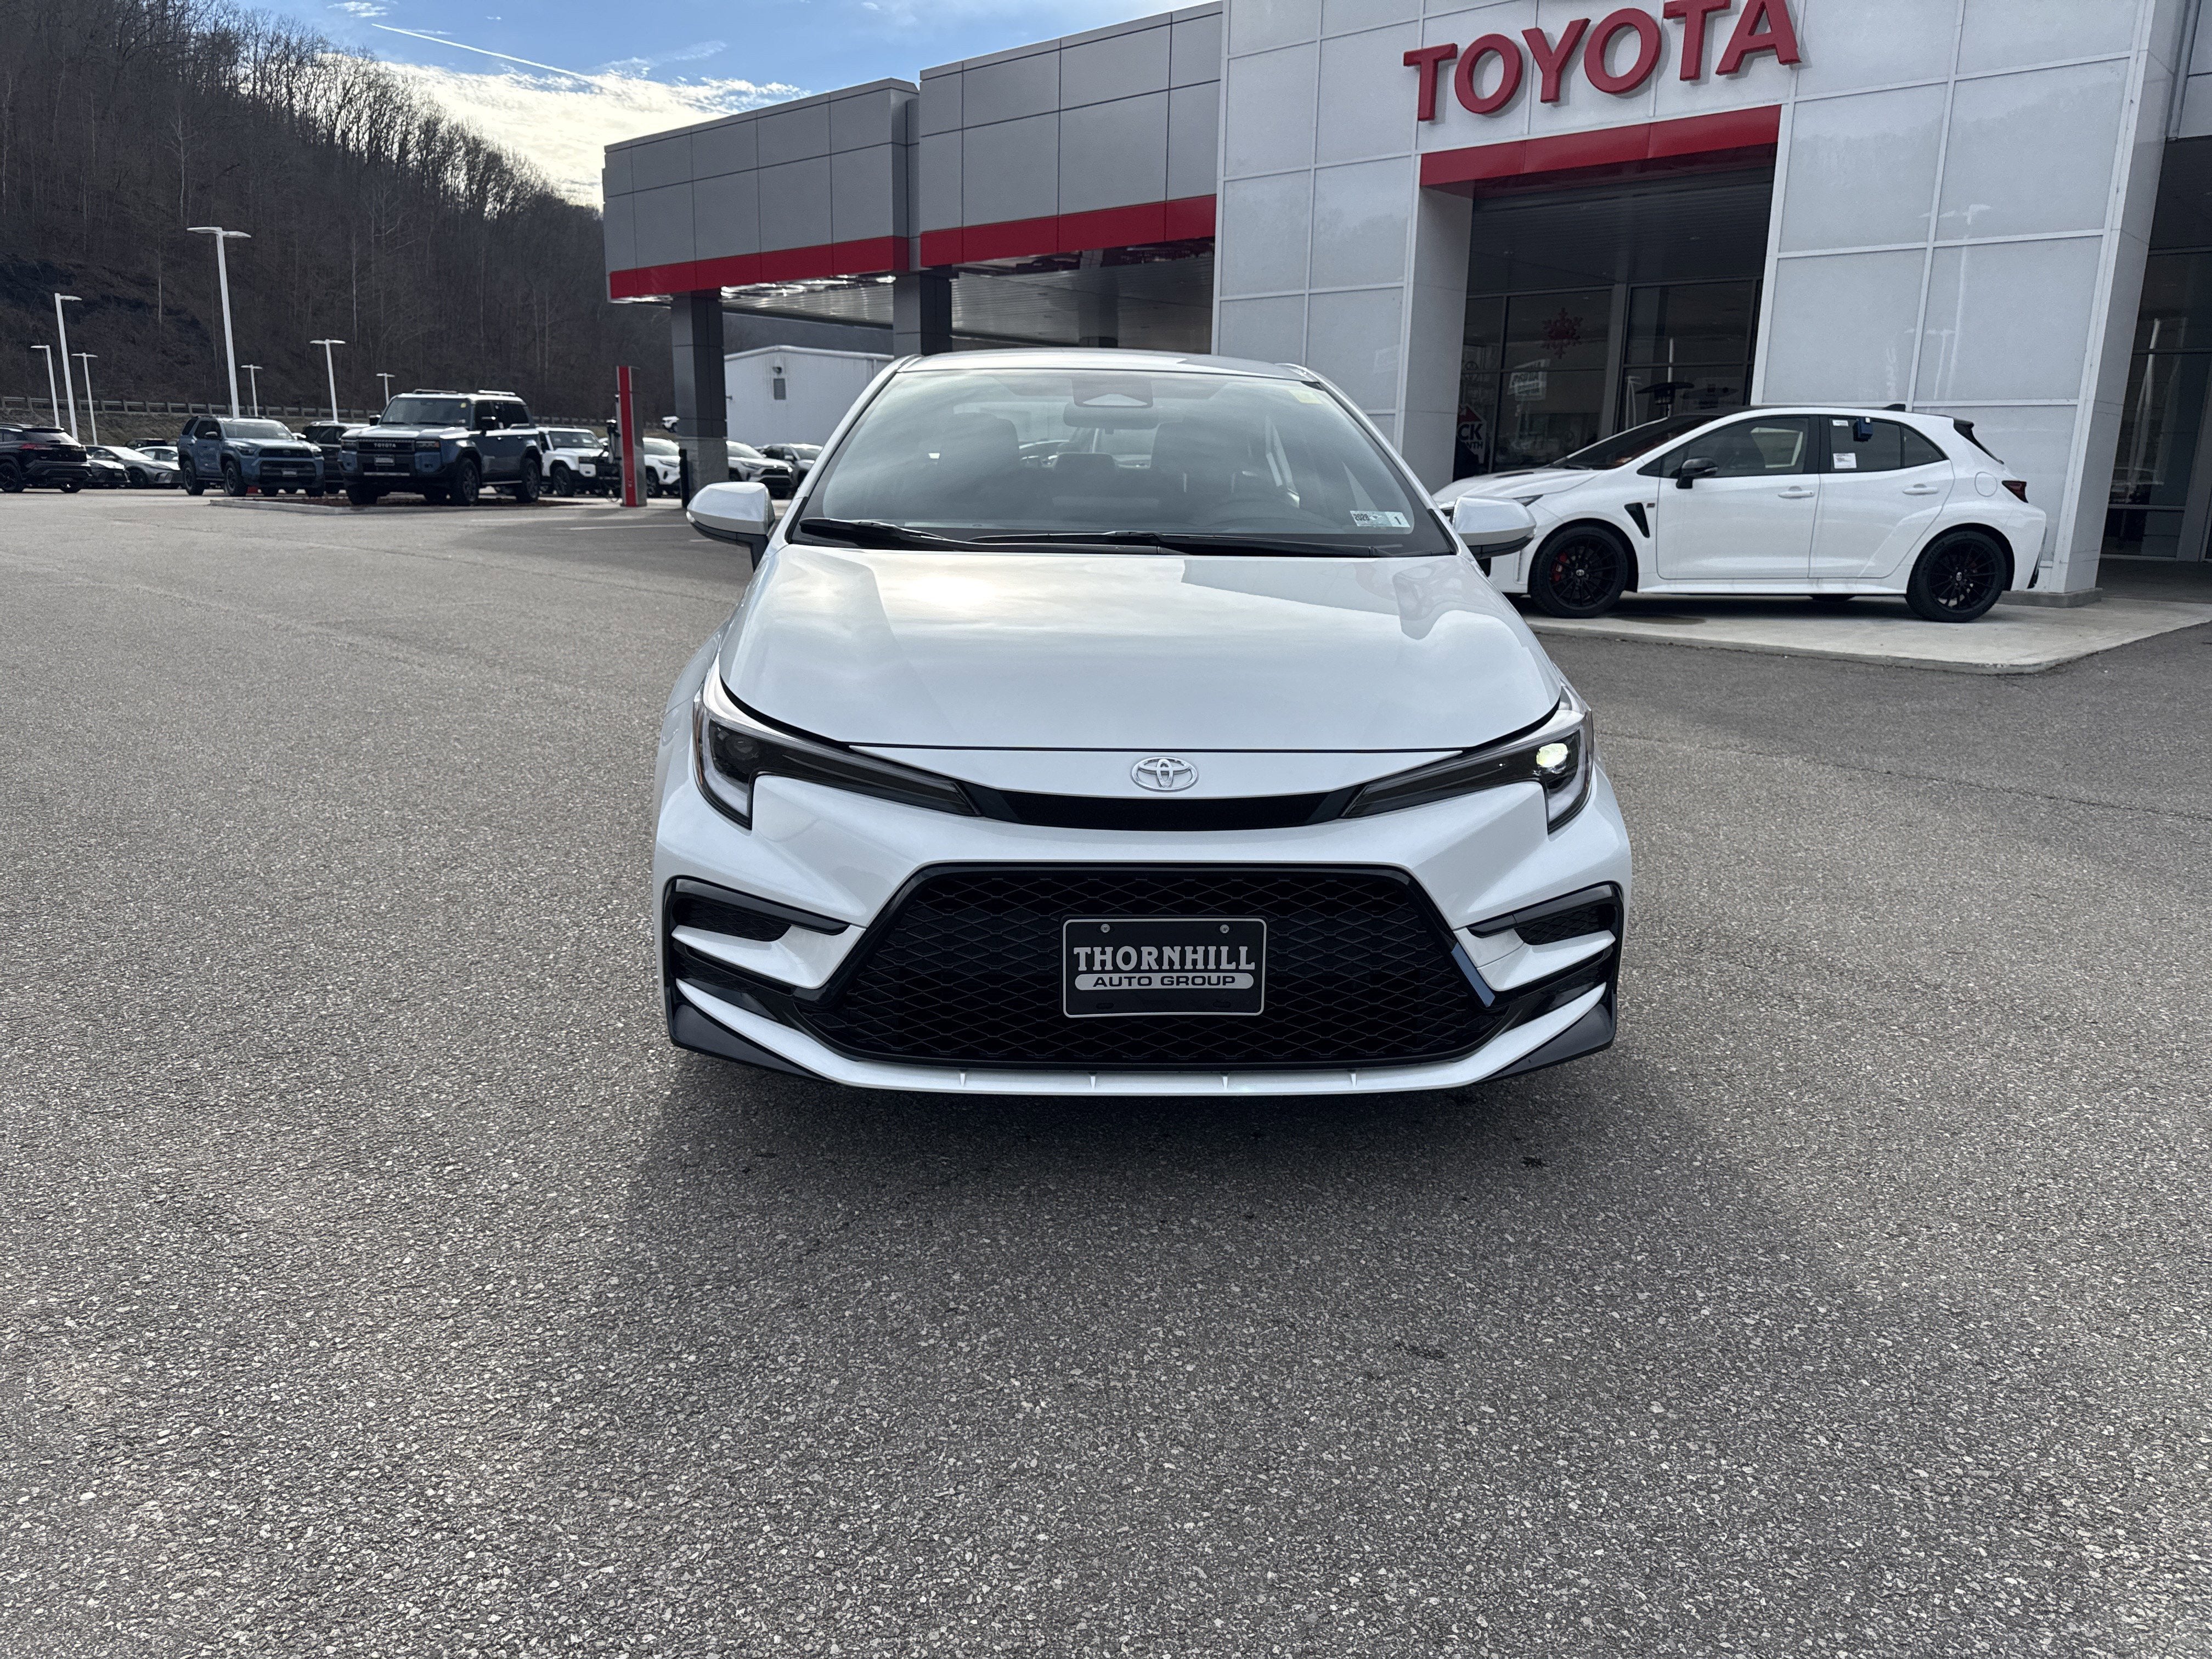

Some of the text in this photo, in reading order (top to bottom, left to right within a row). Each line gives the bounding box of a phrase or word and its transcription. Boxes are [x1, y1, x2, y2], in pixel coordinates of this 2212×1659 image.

[1403, 0, 1802, 122] TOYOTA
[1353, 513, 1370, 521] 2028
[1074, 946, 1255, 971] THORNHILL
[1092, 975, 1236, 988] AUTO GROUP
